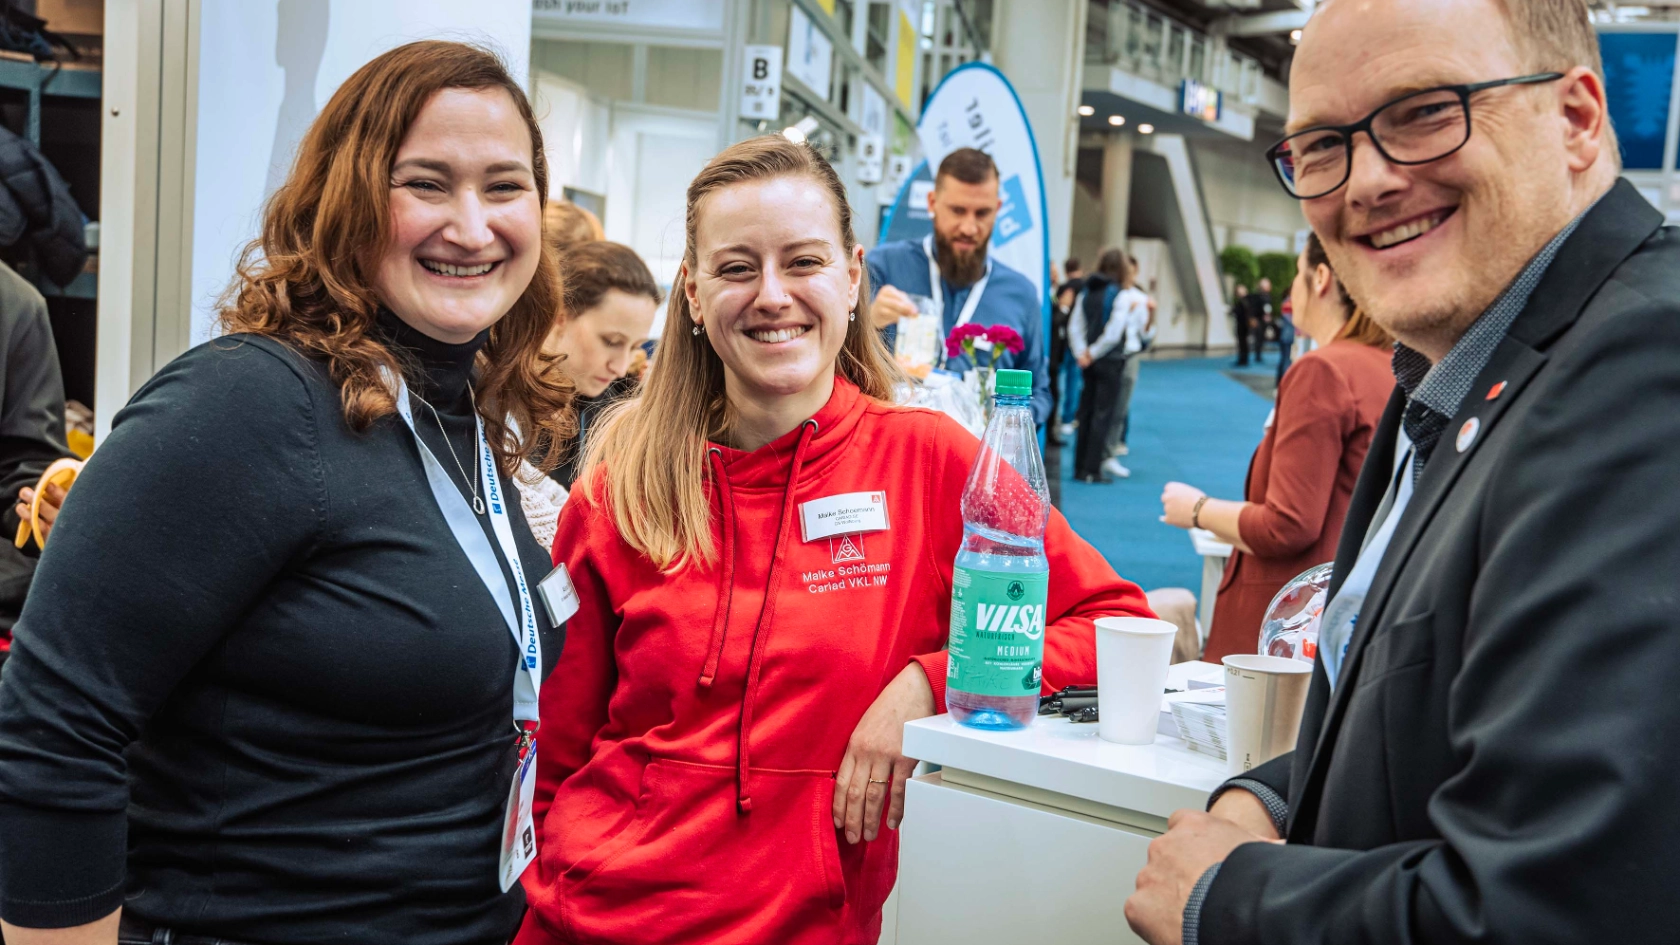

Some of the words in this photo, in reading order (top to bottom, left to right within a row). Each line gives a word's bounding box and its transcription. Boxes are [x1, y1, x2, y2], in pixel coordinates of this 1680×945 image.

[565, 0, 600, 16] your
[753, 58, 768, 80] B
[484, 447, 499, 501] Deutsche
[512, 558, 528, 595] Messe
[802, 569, 835, 582] Maike
[838, 562, 891, 575] Schömann
[808, 581, 846, 594] Cariad
[848, 577, 872, 588] VKL
[873, 574, 888, 586] NW
[524, 597, 537, 654] Deutsche
[975, 602, 1043, 641] VILSA
[997, 645, 1030, 657] MEDIUM
